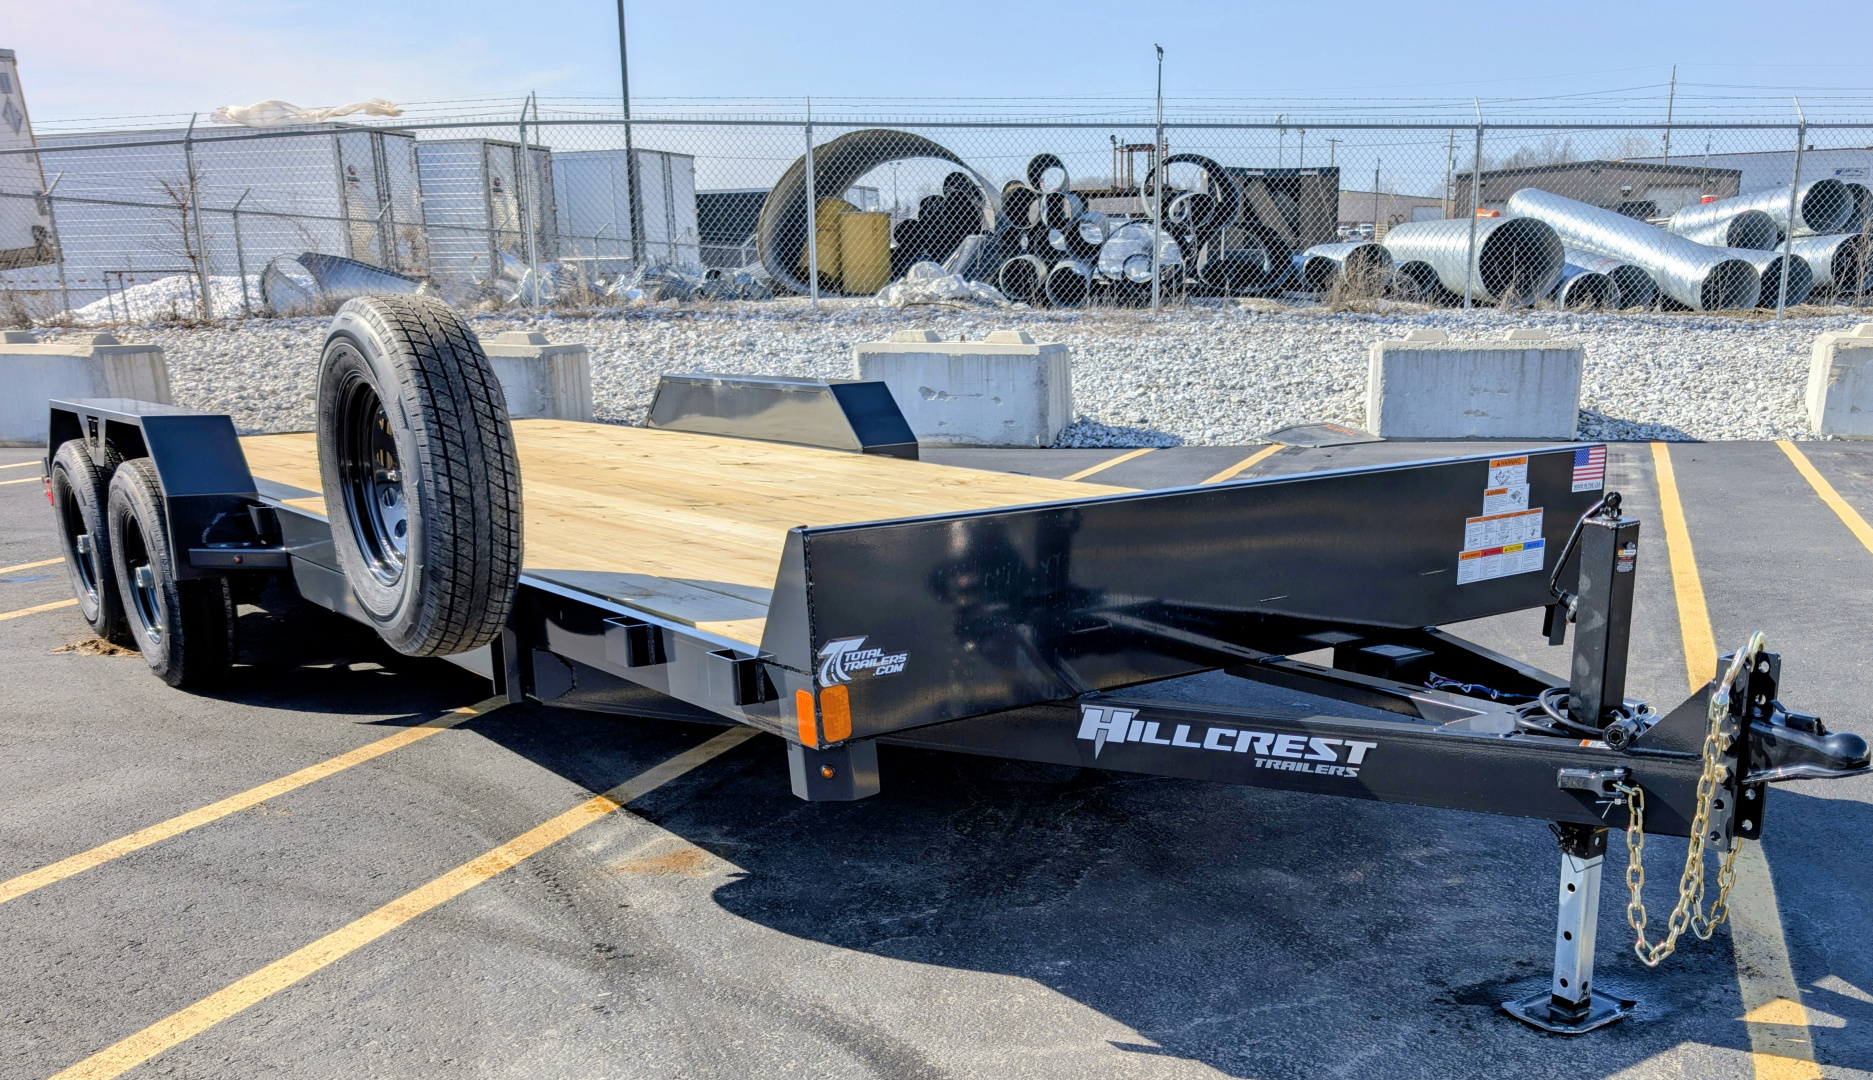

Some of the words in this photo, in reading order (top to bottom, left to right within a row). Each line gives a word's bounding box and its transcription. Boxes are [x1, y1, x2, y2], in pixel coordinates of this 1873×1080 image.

[1500, 458, 1521, 466] WARNING
[843, 648, 885, 662] TOTAL
[843, 653, 908, 672] TRAILERS
[872, 663, 905, 677] .COM
[1077, 703, 1378, 765] HILLCREST
[1253, 757, 1360, 778] TRAILERS
